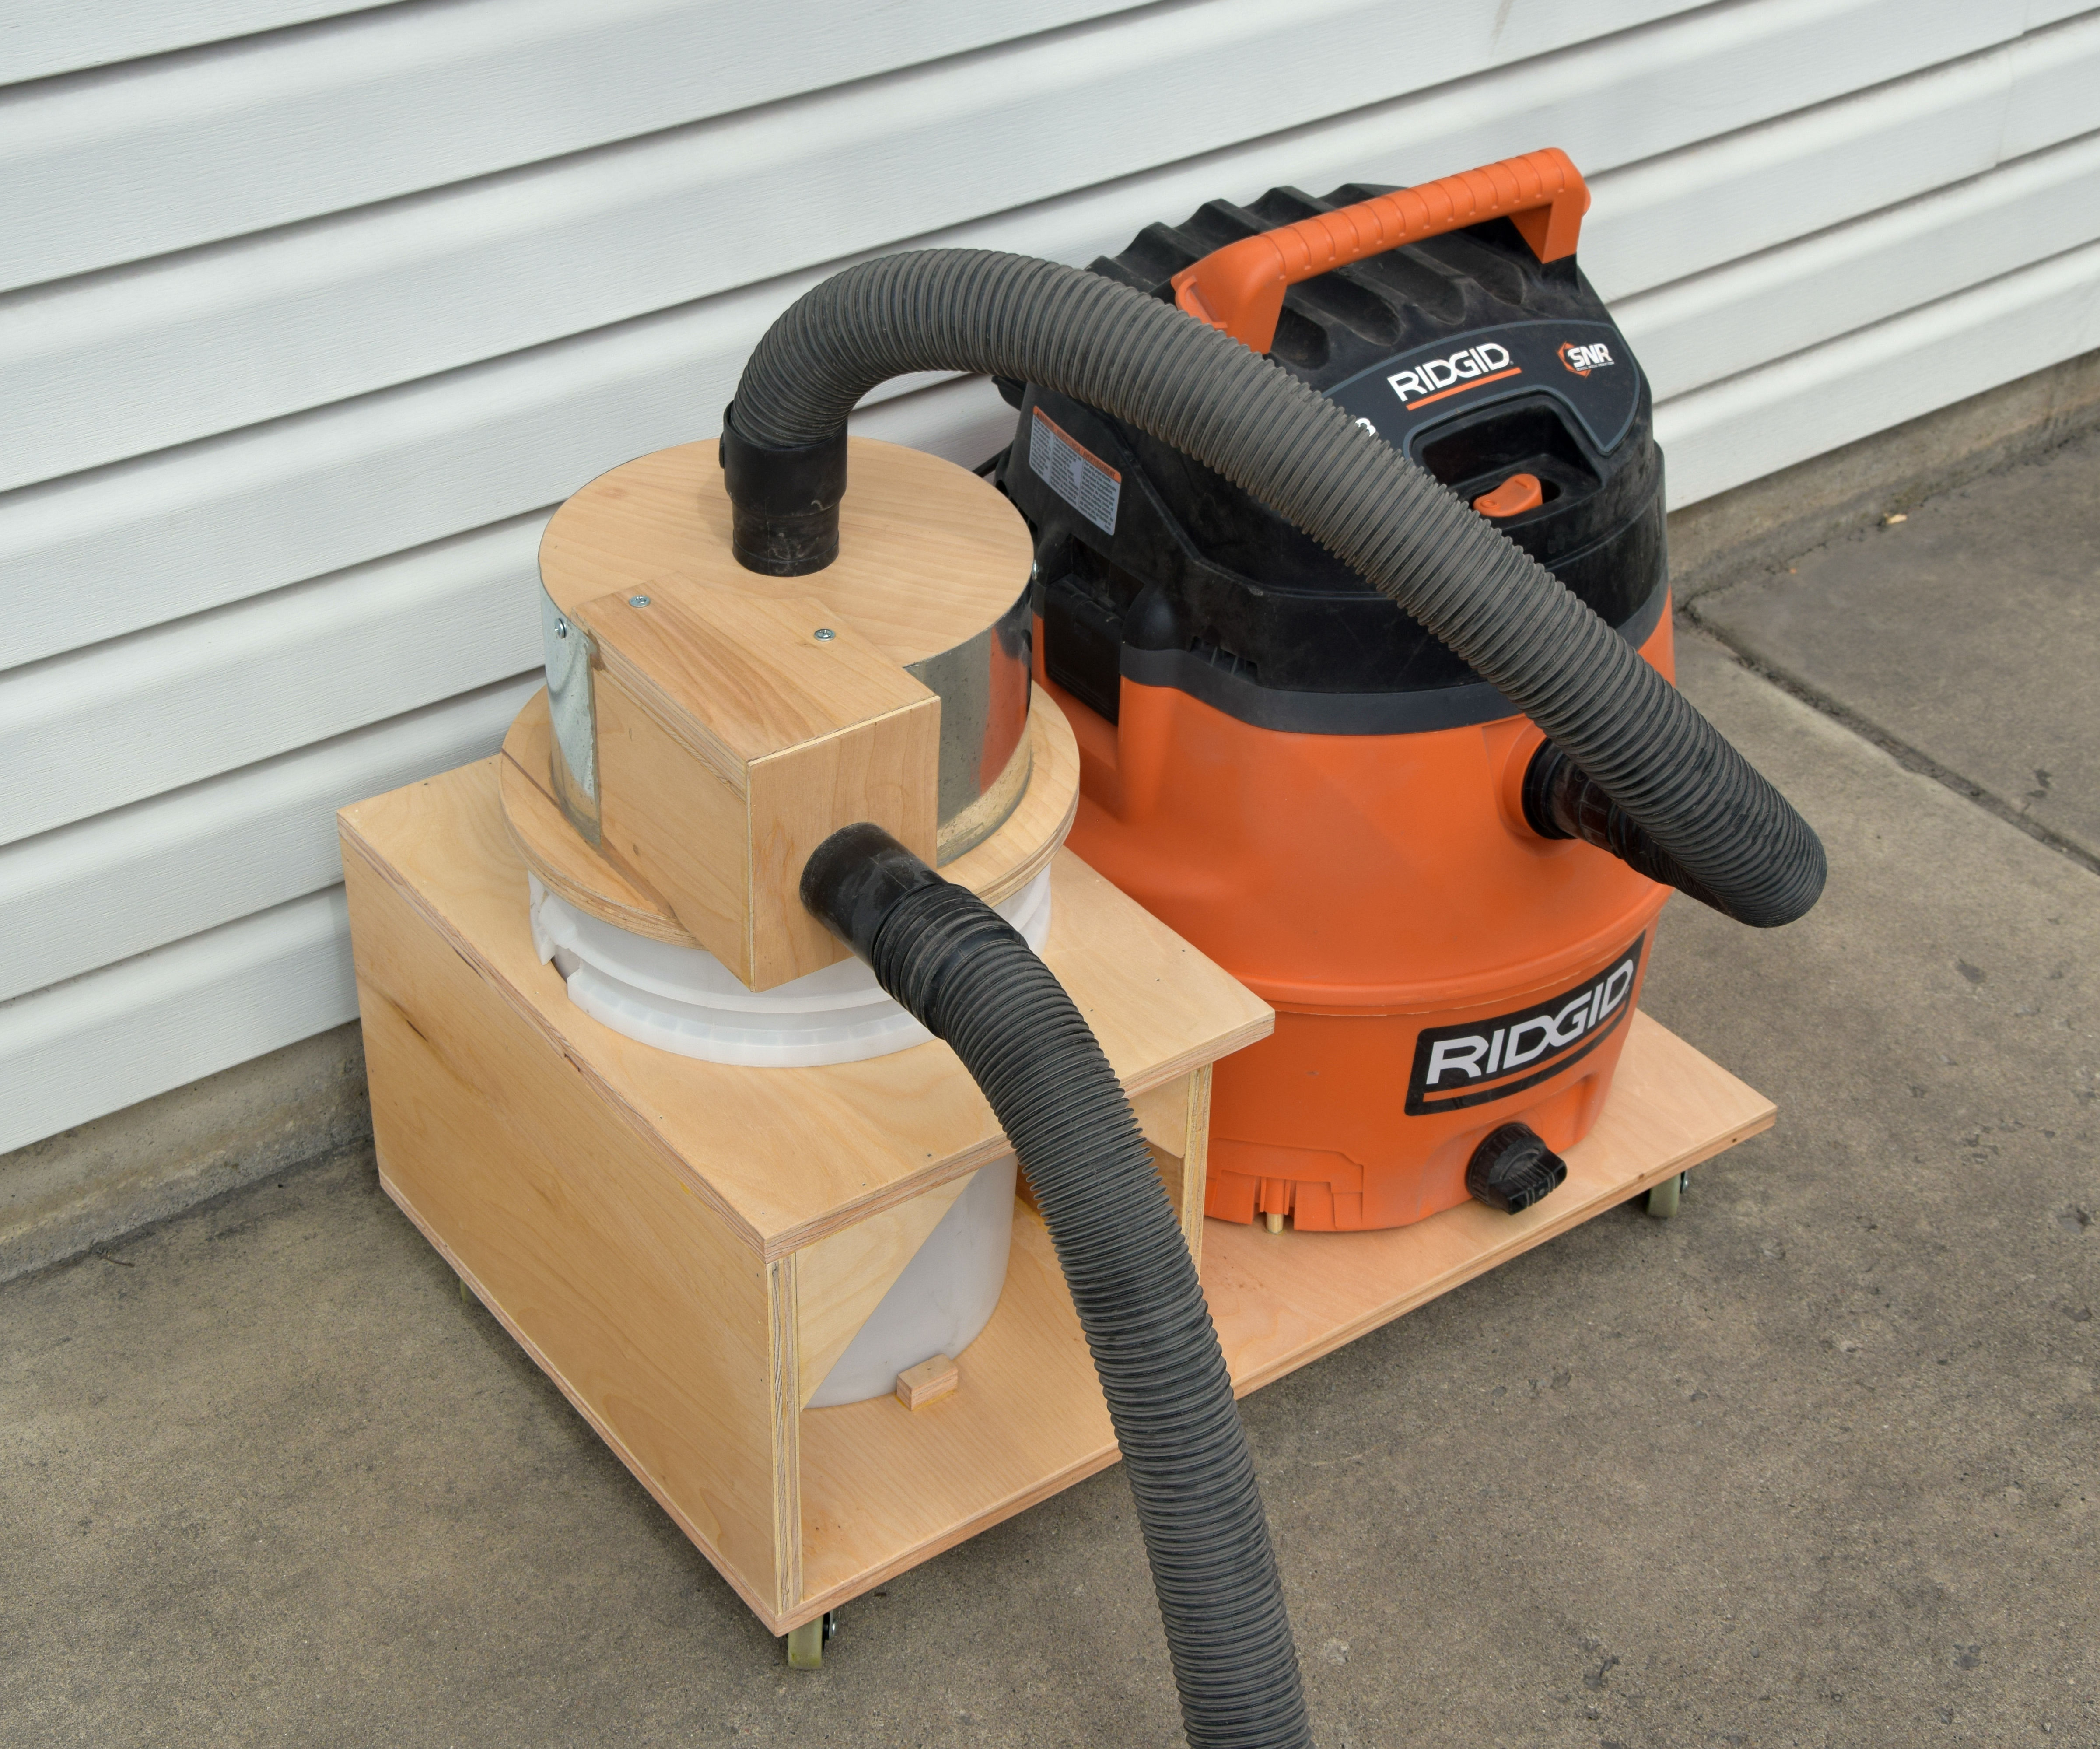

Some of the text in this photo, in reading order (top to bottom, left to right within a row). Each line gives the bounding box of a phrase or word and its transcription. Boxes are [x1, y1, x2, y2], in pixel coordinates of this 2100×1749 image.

[1386, 342, 1510, 402] RIDGID
[1568, 343, 1613, 368] SNR
[1426, 959, 1634, 1085] RIDGID
